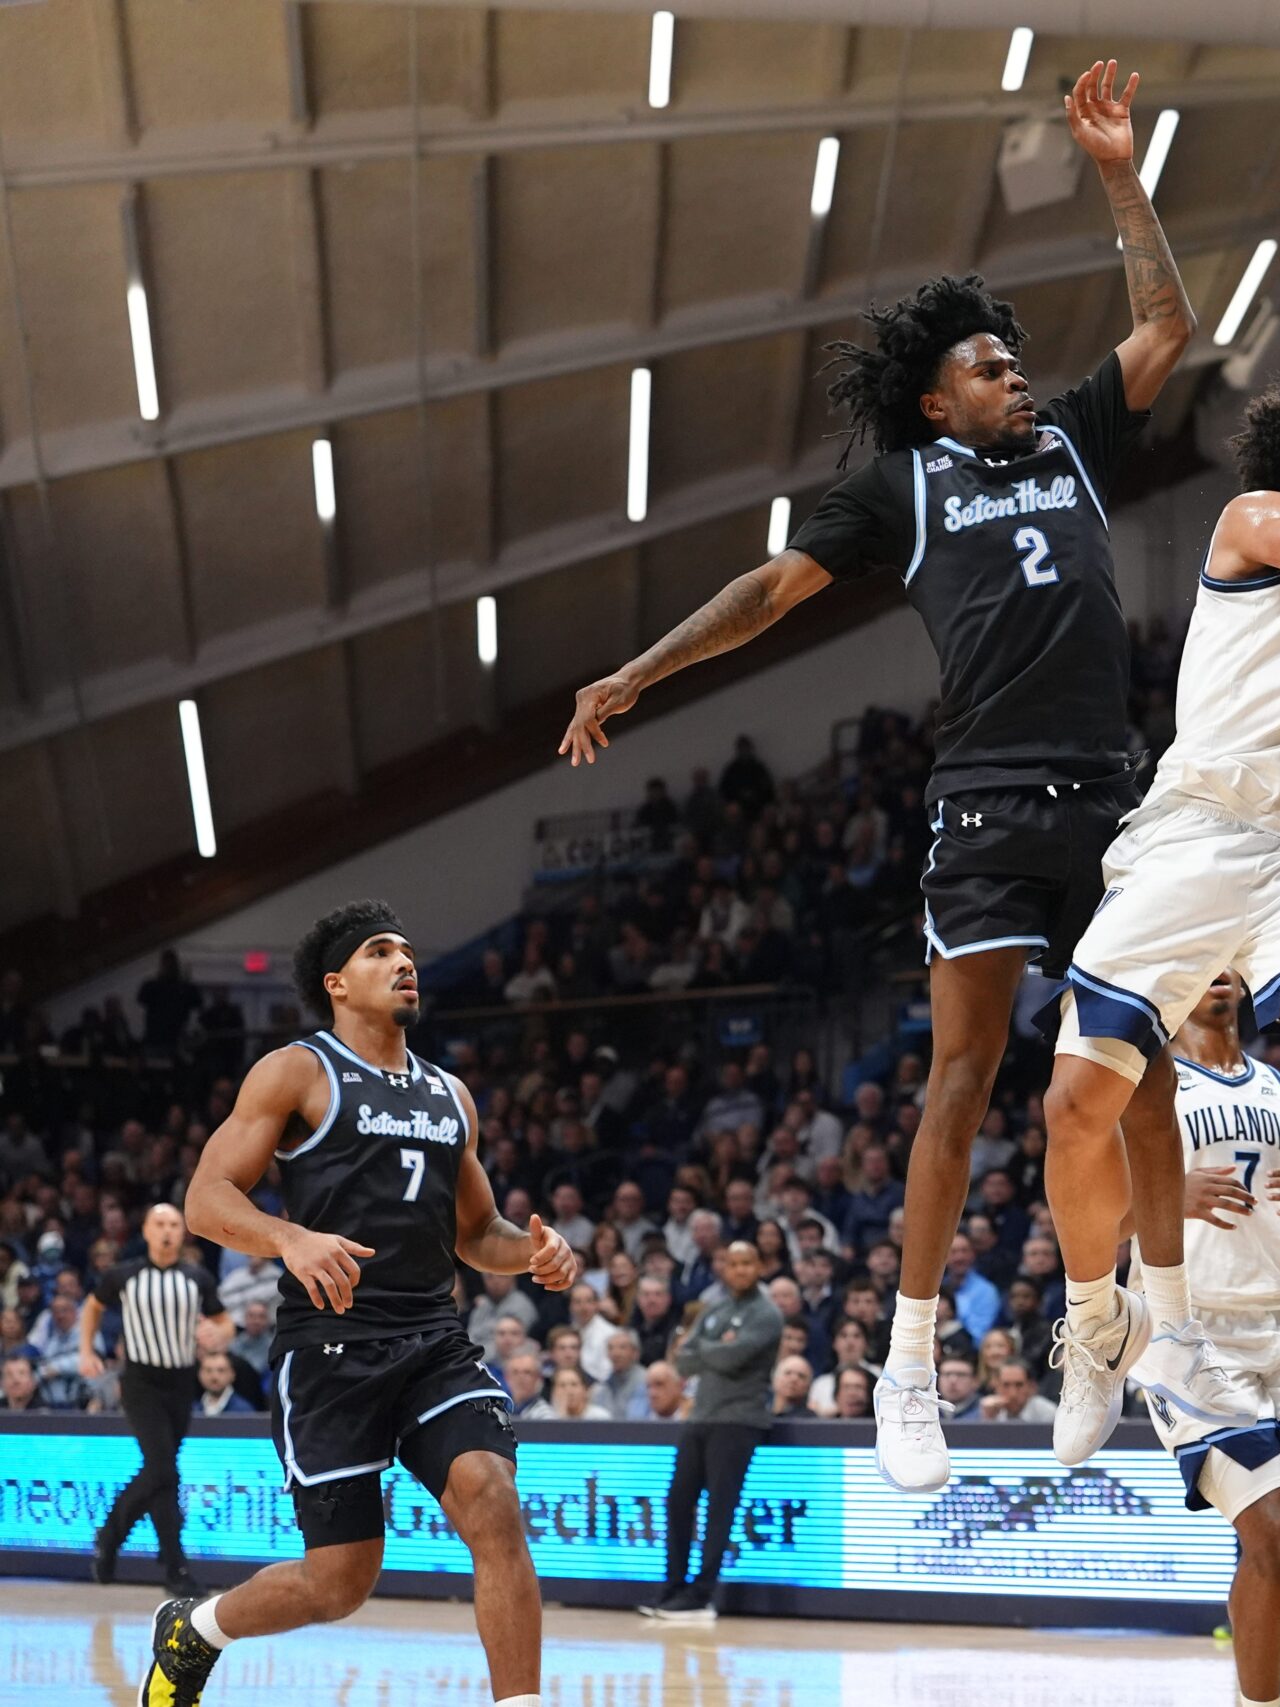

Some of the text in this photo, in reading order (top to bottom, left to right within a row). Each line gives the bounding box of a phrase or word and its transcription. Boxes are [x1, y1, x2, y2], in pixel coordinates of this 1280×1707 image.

[944, 474, 1078, 533] Seton Hall
[1012, 525, 1060, 588] 2
[357, 1104, 459, 1146] Seton Hall
[400, 1148, 426, 1202] 7
[1234, 1151, 1261, 1211] 7
